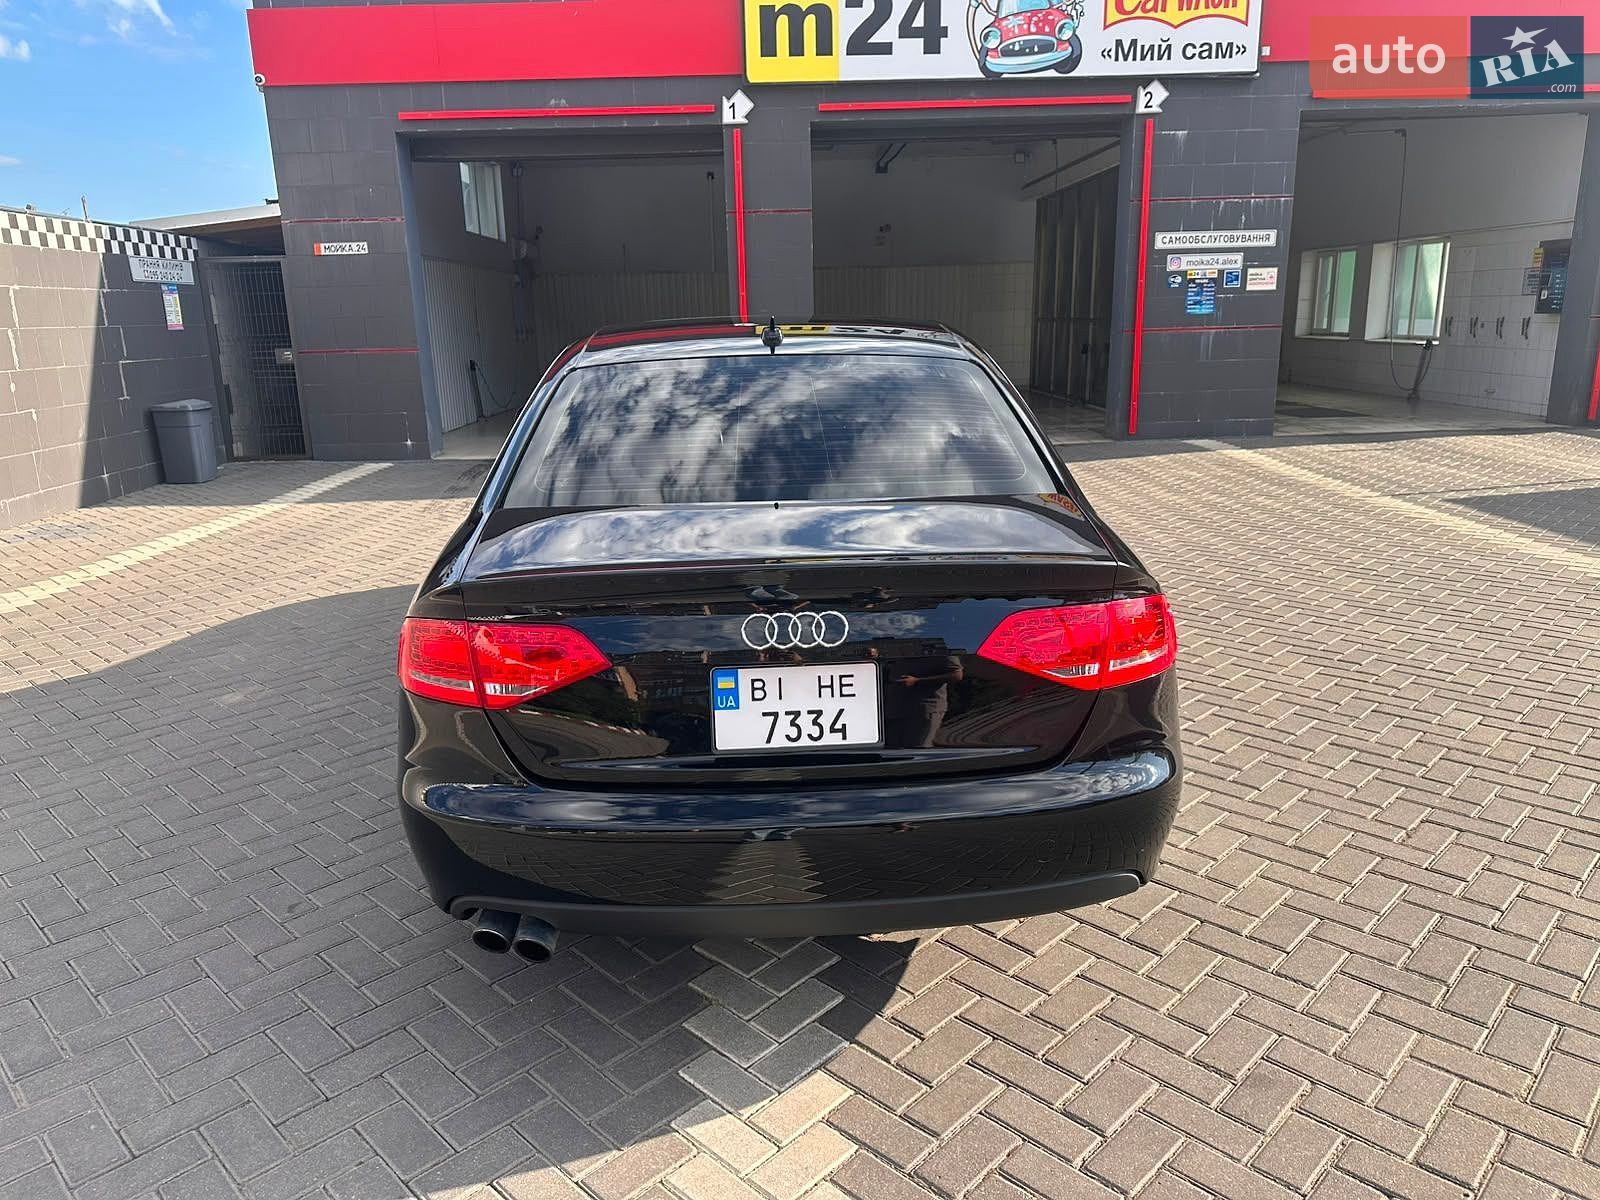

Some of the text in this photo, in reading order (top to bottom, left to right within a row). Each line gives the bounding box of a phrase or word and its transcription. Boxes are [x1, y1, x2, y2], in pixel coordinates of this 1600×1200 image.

[759, 0, 949, 57] m24
[1101, 37, 1247, 62] «Мий сам»
[1143, 91, 1153, 109] 2
[728, 102, 736, 120] 1
[1161, 233, 1271, 245] САМООБСЛУГОВУВАННЯ
[750, 674, 856, 701] BI HE
[717, 695, 736, 708] UA
[761, 708, 848, 744] 7334
